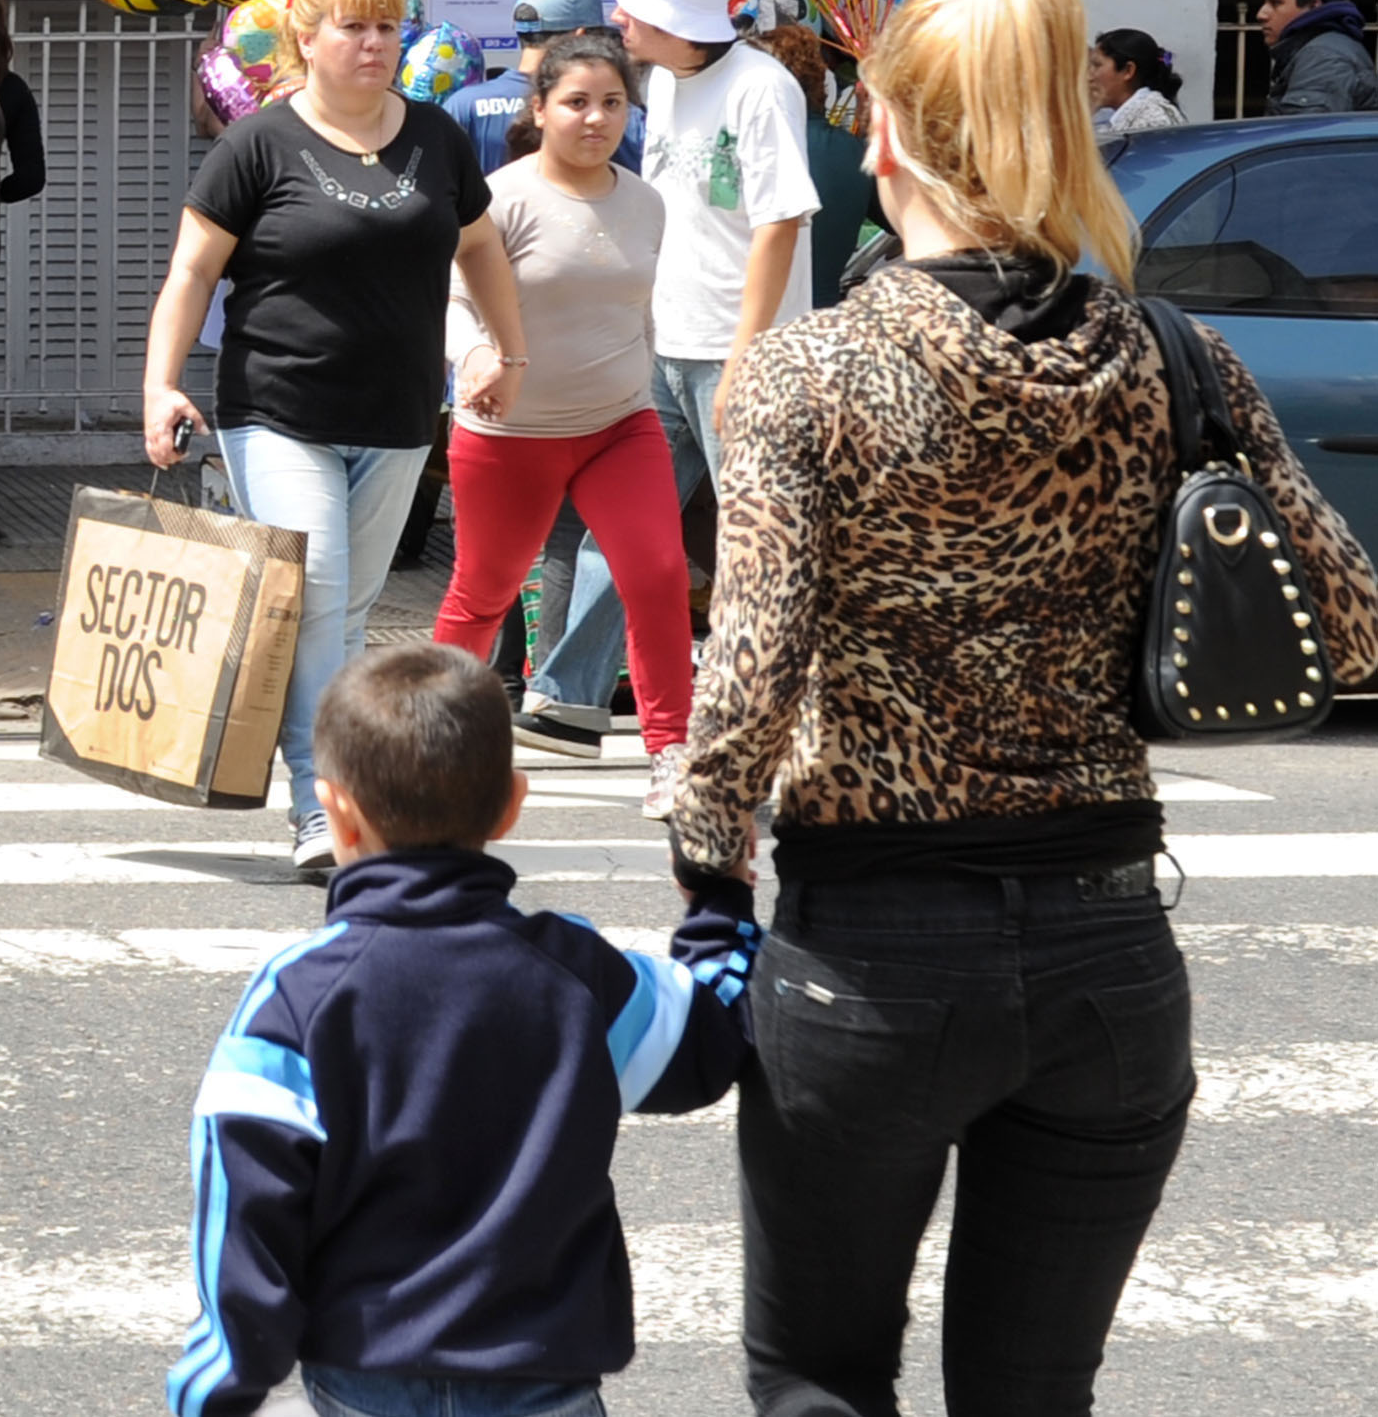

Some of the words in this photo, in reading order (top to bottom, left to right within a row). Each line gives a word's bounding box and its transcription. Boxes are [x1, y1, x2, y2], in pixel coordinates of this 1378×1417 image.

[476, 97, 525, 117] BBVA
[80, 564, 207, 654] SECTOR
[93, 643, 163, 722] DOS
